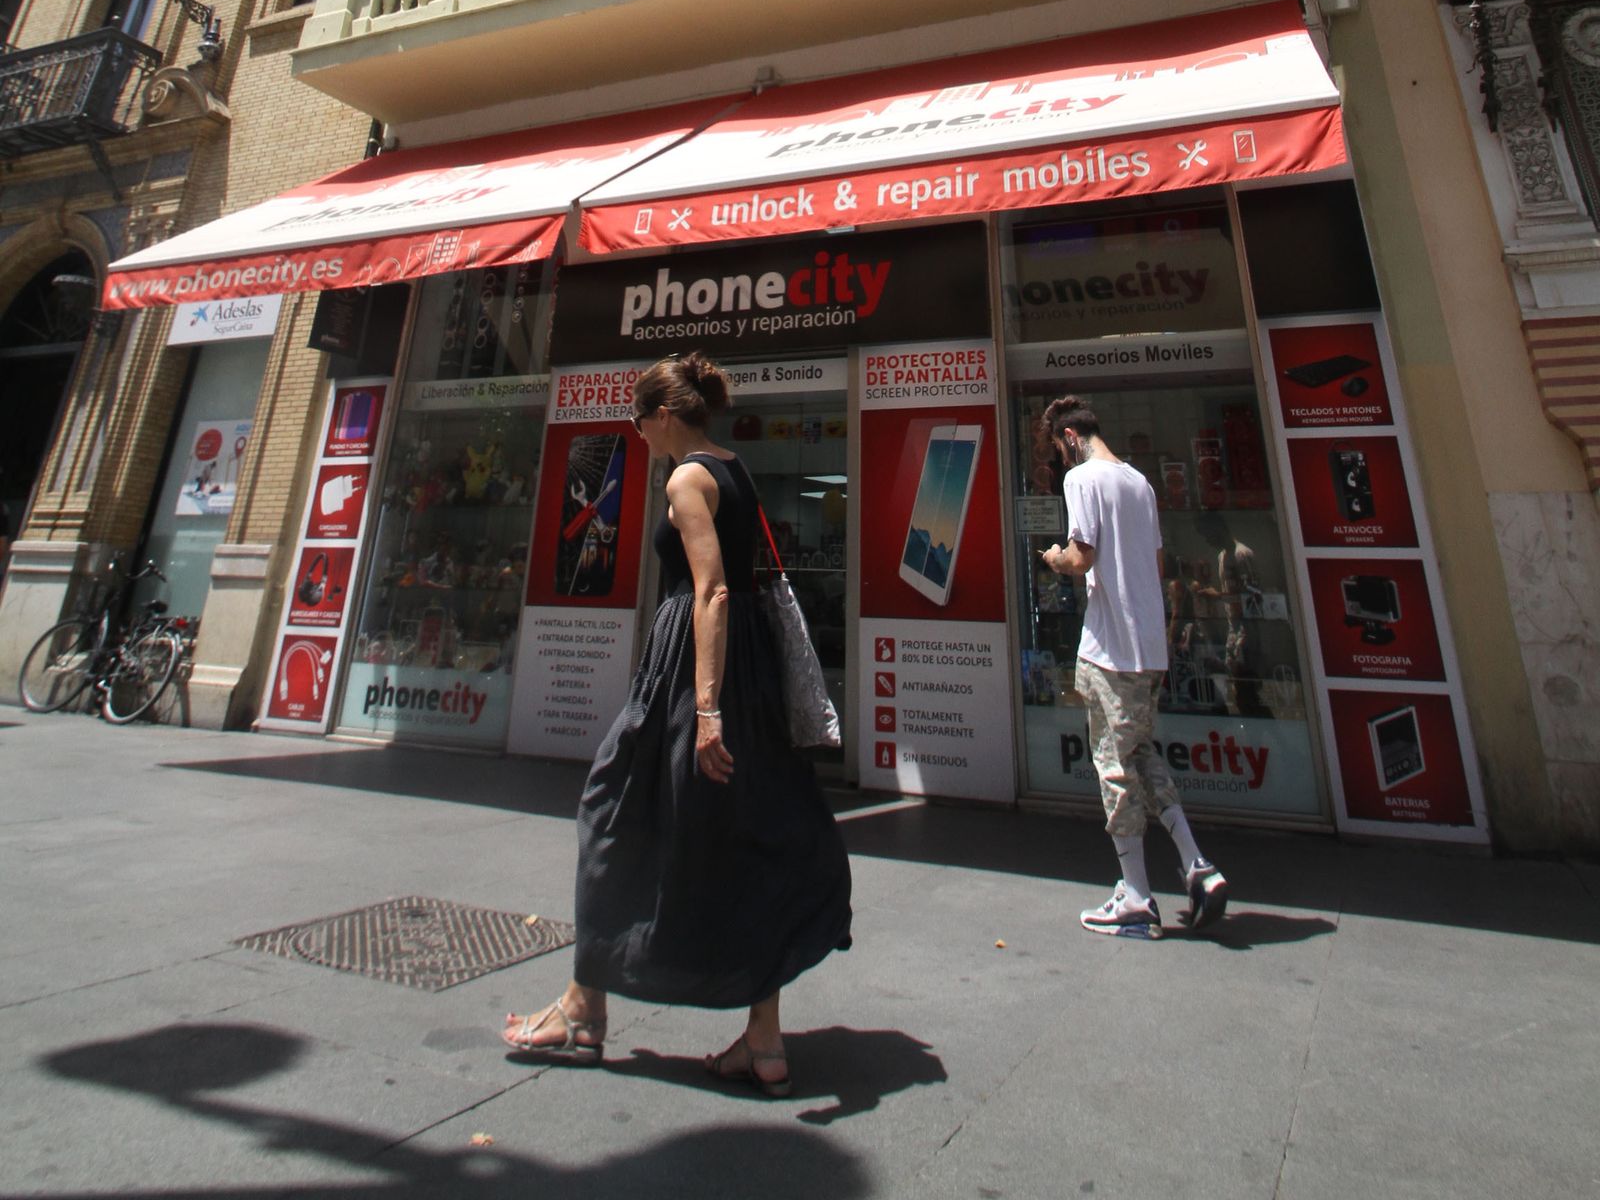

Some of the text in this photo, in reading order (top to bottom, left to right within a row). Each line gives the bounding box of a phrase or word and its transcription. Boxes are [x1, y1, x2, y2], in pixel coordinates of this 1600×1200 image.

[766, 93, 1128, 158] phonecity
[711, 150, 1151, 226] unlock & repair mobiles
[261, 185, 507, 232] phonecity
[109, 256, 344, 300] www.phonecity.es
[1003, 261, 1210, 308] onecity
[620, 251, 893, 336] phonecity
[212, 301, 263, 321] Adeslas
[633, 305, 856, 341] accesorios y reparación
[866, 350, 987, 370] PROTECTORES
[1045, 343, 1214, 368] Accesorios Moviles
[559, 368, 645, 388] REPARACIÓ
[728, 364, 823, 387] agen & Sonido
[866, 365, 988, 386] DE PANTALLA
[421, 383, 474, 399] Liberación
[489, 379, 549, 396] Reparación
[557, 385, 634, 408] EXPRES
[866, 383, 989, 400] SCREEN PROTECTOR
[555, 403, 637, 420] EXPRESS REPA
[1290, 406, 1382, 416] TECLADOS Y RATONES
[1333, 526, 1384, 534] ALTAVOCES
[540, 618, 573, 628] PANTALLA
[542, 633, 610, 645] ENTRADA DE CARGA
[901, 640, 991, 653] PROTEGE HASTA UN
[543, 648, 606, 659] ENTRADA SONIDO
[901, 653, 993, 667] 80% DE LOS GOLPES
[1353, 655, 1412, 666] FOTOGRAFIA
[555, 665, 589, 674] BOTONES
[902, 681, 974, 695] ANTIARAÑAZOS
[363, 676, 488, 725] phonecity
[902, 709, 964, 723] TOTALMENTE
[903, 723, 975, 738] TRANSPARENTE
[903, 752, 968, 768] SIN RESIDUOS
[1060, 722, 1269, 789] pecity
[1173, 774, 1248, 793] eparación
[1385, 796, 1431, 808] BATERIAS
